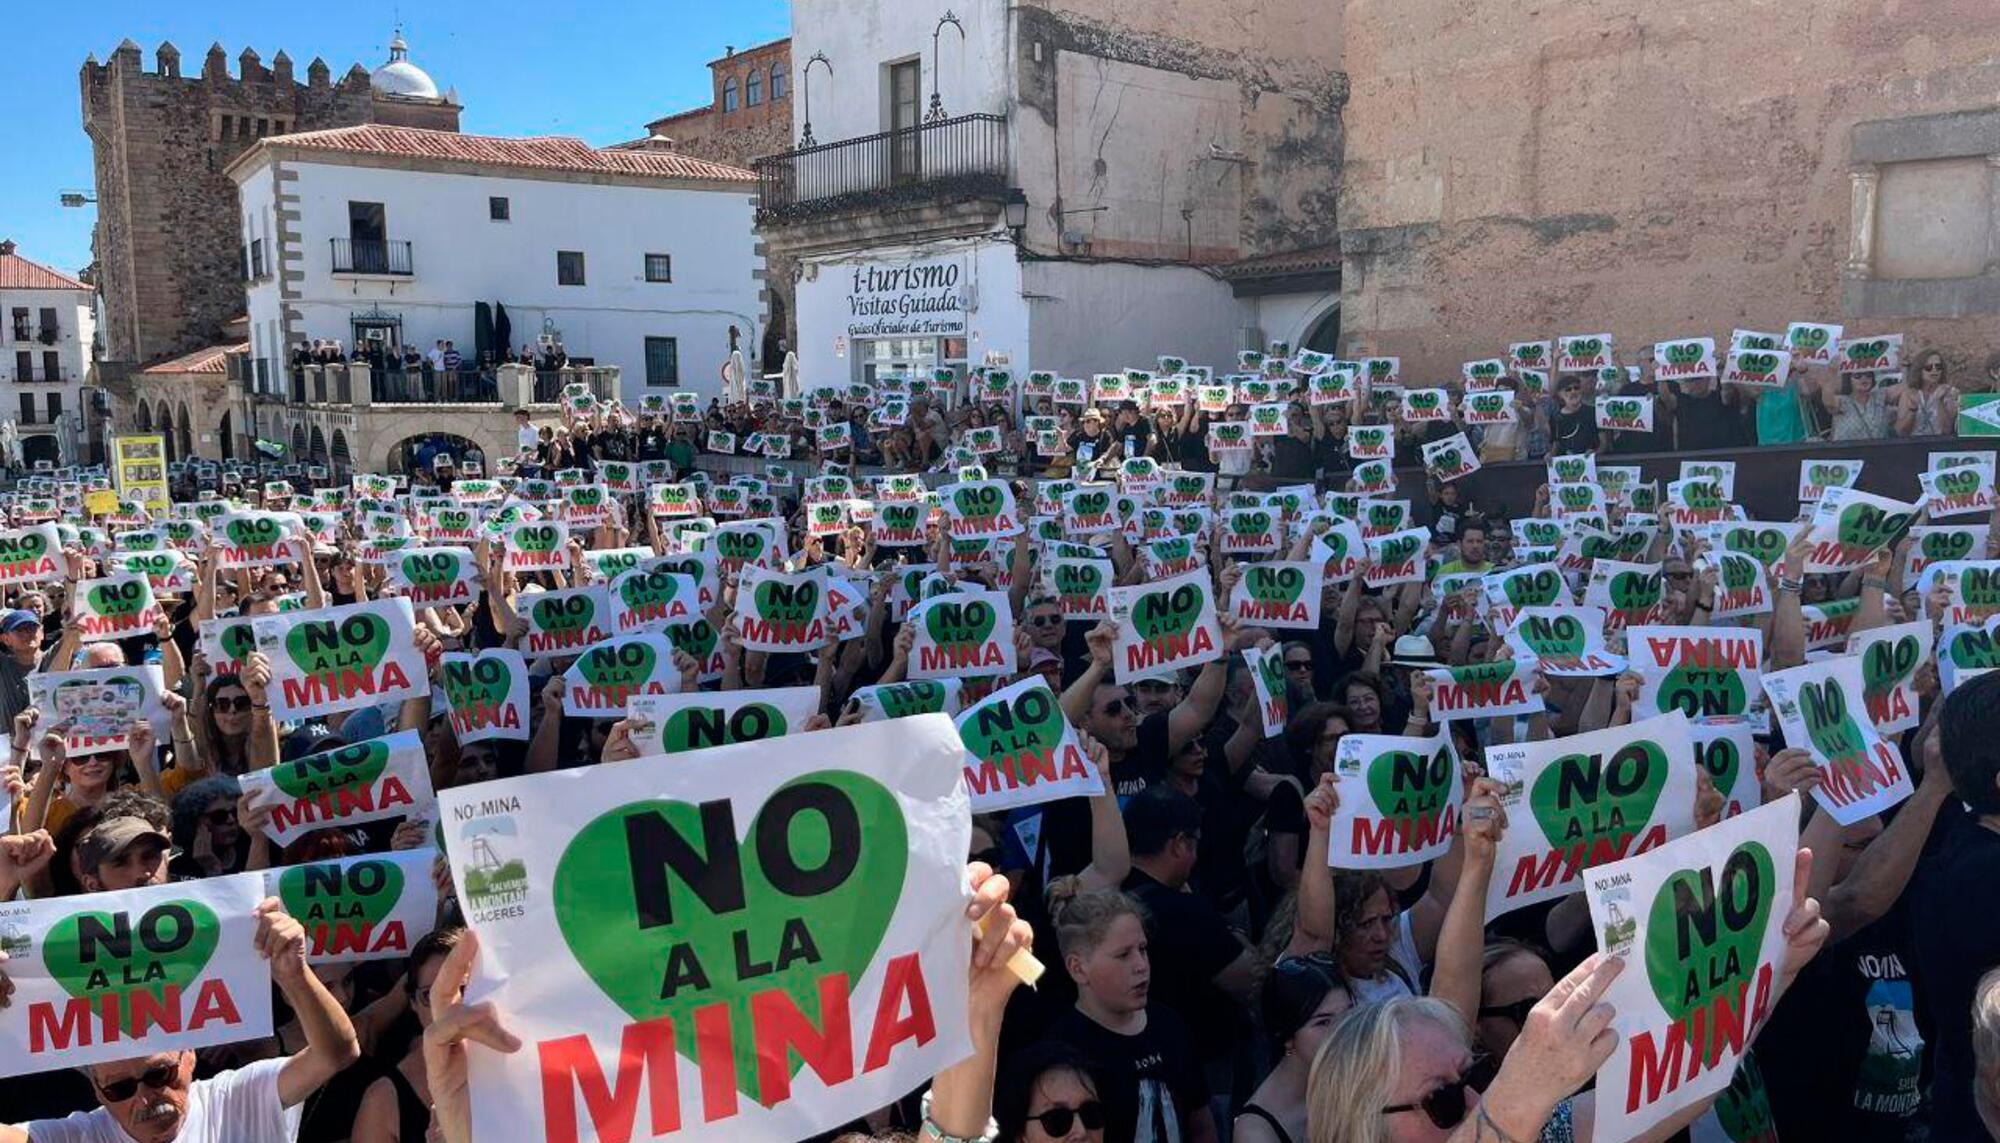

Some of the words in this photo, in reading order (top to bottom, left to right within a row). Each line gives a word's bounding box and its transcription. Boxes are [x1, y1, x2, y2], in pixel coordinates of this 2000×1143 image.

[847, 295, 896, 316] Visitas
[910, 320, 920, 333] de
[923, 319, 963, 333] Turismo
[1798, 327, 1824, 341] NO
[1574, 340, 1598, 351] NO
[1673, 343, 1698, 356] NO
[1513, 357, 1546, 368] MINA
[1564, 356, 1606, 367] MINA
[1661, 362, 1709, 376] MINA
[1746, 354, 1773, 368] NO
[1840, 357, 1890, 370] MINA
[1729, 371, 1778, 384] MINA
[1315, 390, 1351, 400] MINA
[1407, 408, 1444, 419] MINA
[1469, 411, 1509, 422] MINA
[1222, 425, 1239, 435] NO
[1603, 418, 1645, 430] MINA
[1214, 439, 1248, 448] MINA
[1360, 430, 1380, 440] NO
[1353, 446, 1388, 455] MINA
[1816, 464, 1843, 478] NO
[1943, 470, 1974, 485] NO
[370, 478, 388, 489] NO
[827, 479, 844, 489] NO
[896, 479, 912, 488] NO
[1179, 477, 1200, 487] NO
[578, 488, 597, 499] NO
[666, 488, 686, 498] NO
[963, 486, 997, 506] NO
[1936, 492, 1987, 512] MINA
[201, 503, 221, 514] NO
[444, 511, 467, 522] NO
[570, 506, 607, 518] MINA
[655, 503, 692, 513] MINA
[712, 502, 744, 512] MINA
[821, 505, 838, 517] NO
[890, 507, 916, 520] NO
[1376, 505, 1399, 519] NO
[237, 518, 274, 535] NO
[813, 522, 844, 533] MINA
[953, 516, 1014, 536] MINA
[1071, 513, 1115, 529] MINA
[1239, 512, 1265, 526] NO
[130, 534, 156, 544] NO
[435, 528, 475, 539] MINA
[523, 526, 554, 542] NO
[726, 533, 757, 549] NO
[877, 528, 925, 541] MINA
[1227, 533, 1274, 549] MINA
[1736, 529, 1777, 548] NO
[1932, 531, 1967, 549] NO
[136, 555, 167, 568] NO
[224, 542, 292, 563] MINA
[511, 551, 564, 565] MINA
[606, 553, 637, 568] NO
[412, 553, 451, 574] NO
[1063, 564, 1096, 583] NO
[1152, 558, 1200, 578] MINA
[1367, 561, 1415, 581] MINA
[629, 573, 669, 595] NO
[1257, 566, 1297, 589] NO
[1515, 570, 1552, 593] NO
[101, 580, 141, 603] NO
[401, 580, 470, 604] MINA
[768, 582, 813, 608] NO
[1719, 586, 1763, 612] MINA
[544, 594, 586, 618] NO
[1057, 595, 1107, 614] MINA
[1146, 585, 1195, 620] NO
[1238, 599, 1309, 622] MINA
[84, 610, 158, 635] MINA
[619, 601, 689, 631] MINA
[784, 608, 803, 620] LA
[940, 602, 986, 628] NO
[303, 615, 375, 653] NO
[672, 619, 710, 646] NO
[742, 616, 823, 645] MINA
[1150, 623, 1160, 635] A
[1163, 618, 1182, 631] LA
[1530, 615, 1576, 641] NO
[530, 626, 601, 653] MINA
[1127, 625, 1214, 673] MINA
[315, 657, 328, 670] A
[336, 650, 363, 666] LA
[592, 642, 645, 669] NO
[920, 642, 1005, 671] MINA
[1647, 636, 1757, 669] MINA
[1875, 635, 1920, 677] NO
[445, 657, 500, 687] NO
[614, 669, 634, 681] LA
[1477, 667, 1497, 679] LA
[282, 661, 411, 709] MINA
[468, 689, 492, 701] LA
[886, 680, 936, 702] NO
[1437, 679, 1527, 711] MINA
[976, 690, 1051, 737] NO
[1670, 689, 1728, 718] NO
[1807, 677, 1840, 730] NO
[450, 702, 521, 735] MINA
[688, 705, 770, 748] NO
[989, 738, 1006, 755] A
[1013, 731, 1042, 749] LA
[294, 742, 372, 779] NO
[963, 744, 1089, 795] MINA
[1392, 748, 1449, 792] NO
[305, 781, 321, 795] A
[325, 772, 359, 788] LA
[1557, 745, 1650, 811] NO
[1817, 742, 1901, 808] MINA
[271, 776, 414, 834] MINA
[481, 796, 522, 815] MINA
[1394, 798, 1408, 814] A
[1416, 793, 1437, 811] LA
[1351, 803, 1455, 855] MINA
[1564, 816, 1583, 841] A
[1591, 805, 1626, 834] LA
[623, 782, 861, 930] NO
[304, 861, 387, 897] NO
[308, 903, 325, 919] A
[334, 902, 365, 919] LA
[1673, 849, 1759, 961] NO
[77, 904, 195, 964] NO
[304, 921, 408, 956] INA
[660, 942, 711, 1000] A
[732, 919, 821, 981] LA
[86, 968, 111, 990] A
[123, 961, 167, 985] LA
[1684, 968, 1701, 1007] A
[1709, 946, 1741, 988] LA
[28, 978, 242, 1053] MINA
[537, 952, 937, 1143] MINA
[1625, 961, 1773, 1115] MINA
